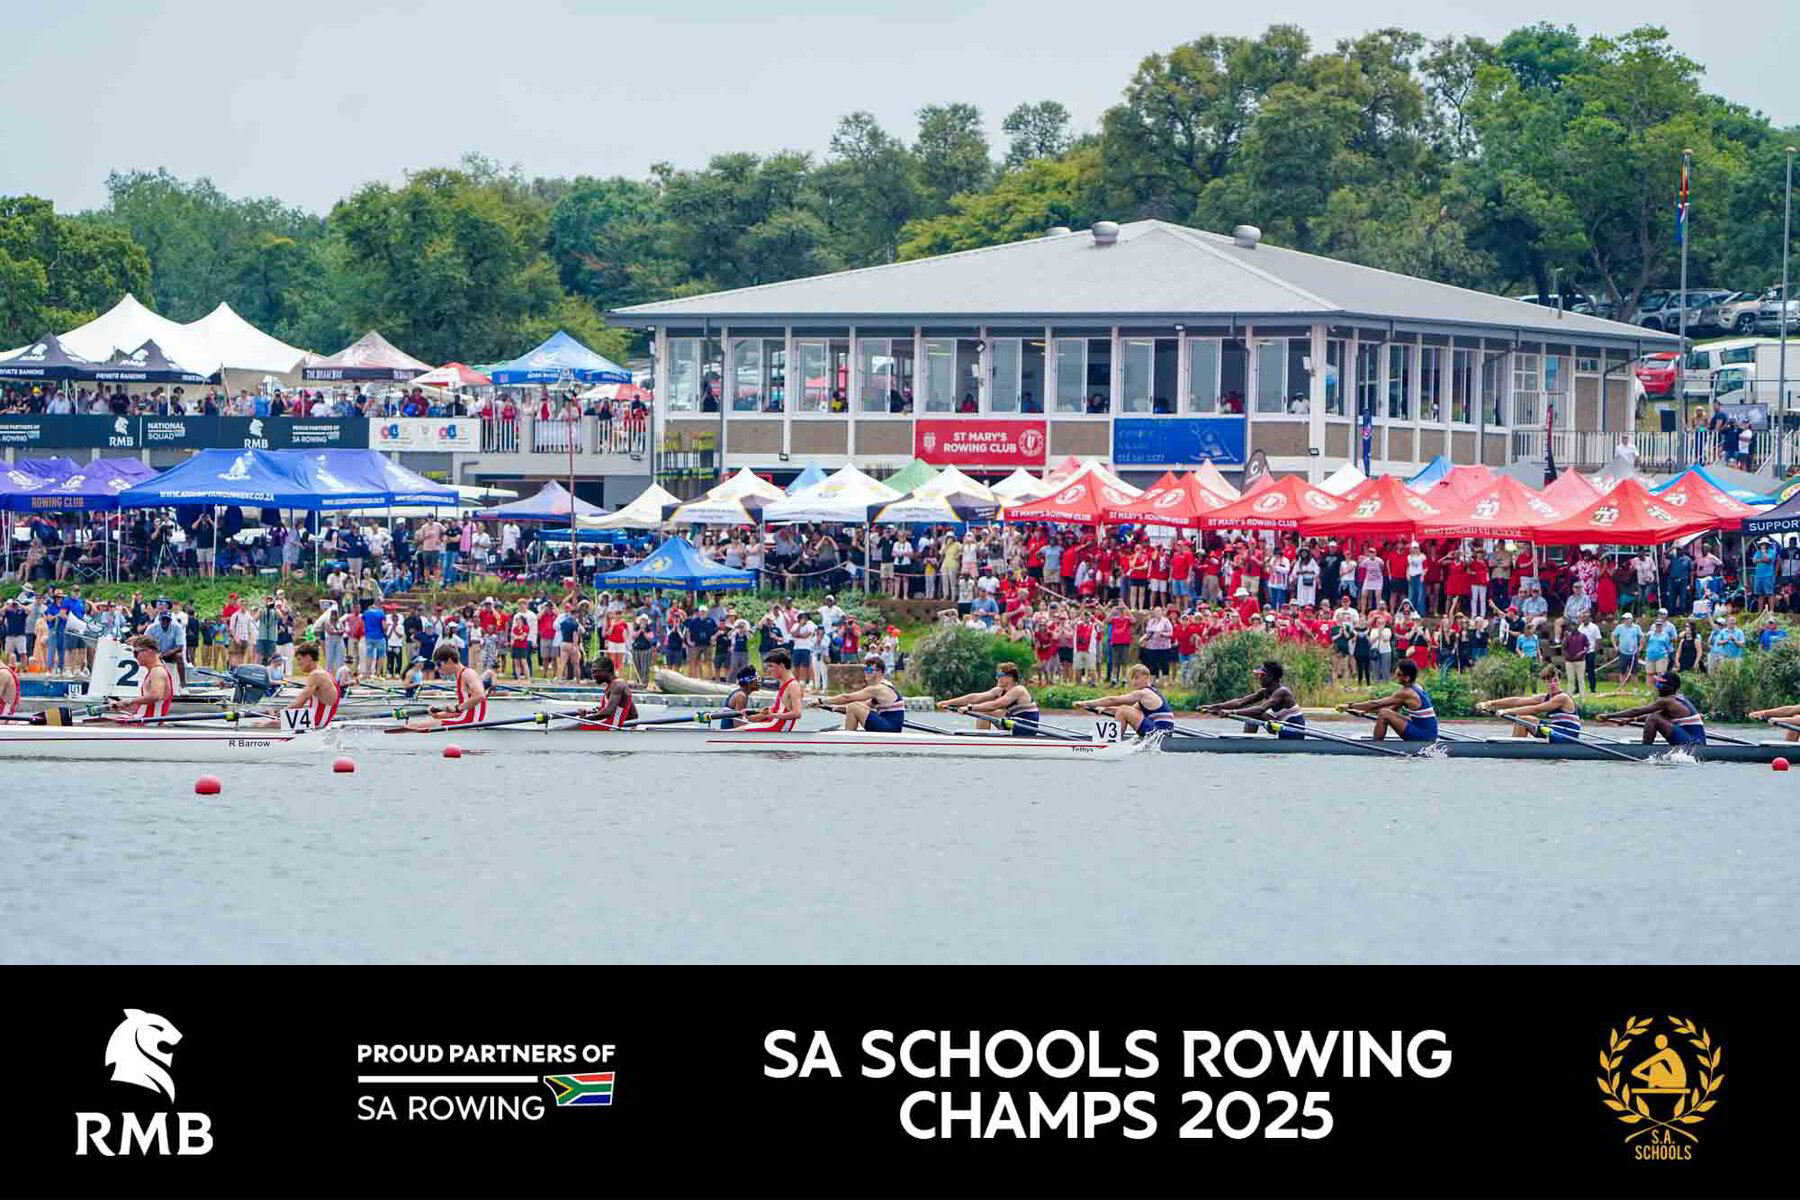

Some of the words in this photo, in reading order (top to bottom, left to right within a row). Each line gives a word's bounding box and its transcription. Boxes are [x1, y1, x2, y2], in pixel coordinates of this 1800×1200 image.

[147, 432, 175, 440] SQUAD
[953, 432, 966, 442] ST
[968, 432, 1008, 442] MARY'S
[109, 437, 134, 447] RMB
[244, 438, 269, 449] RMB
[943, 443, 987, 453] ROWING
[989, 443, 1017, 453] CLUB
[31, 496, 62, 509] ROWING
[64, 496, 84, 509] CLUB
[1247, 519, 1277, 527] ROWING
[1279, 519, 1297, 527] CLUB
[1749, 520, 1800, 531] SUPPOR
[116, 659, 139, 686] 2
[285, 709, 311, 729] V4
[1096, 722, 1118, 739] V3
